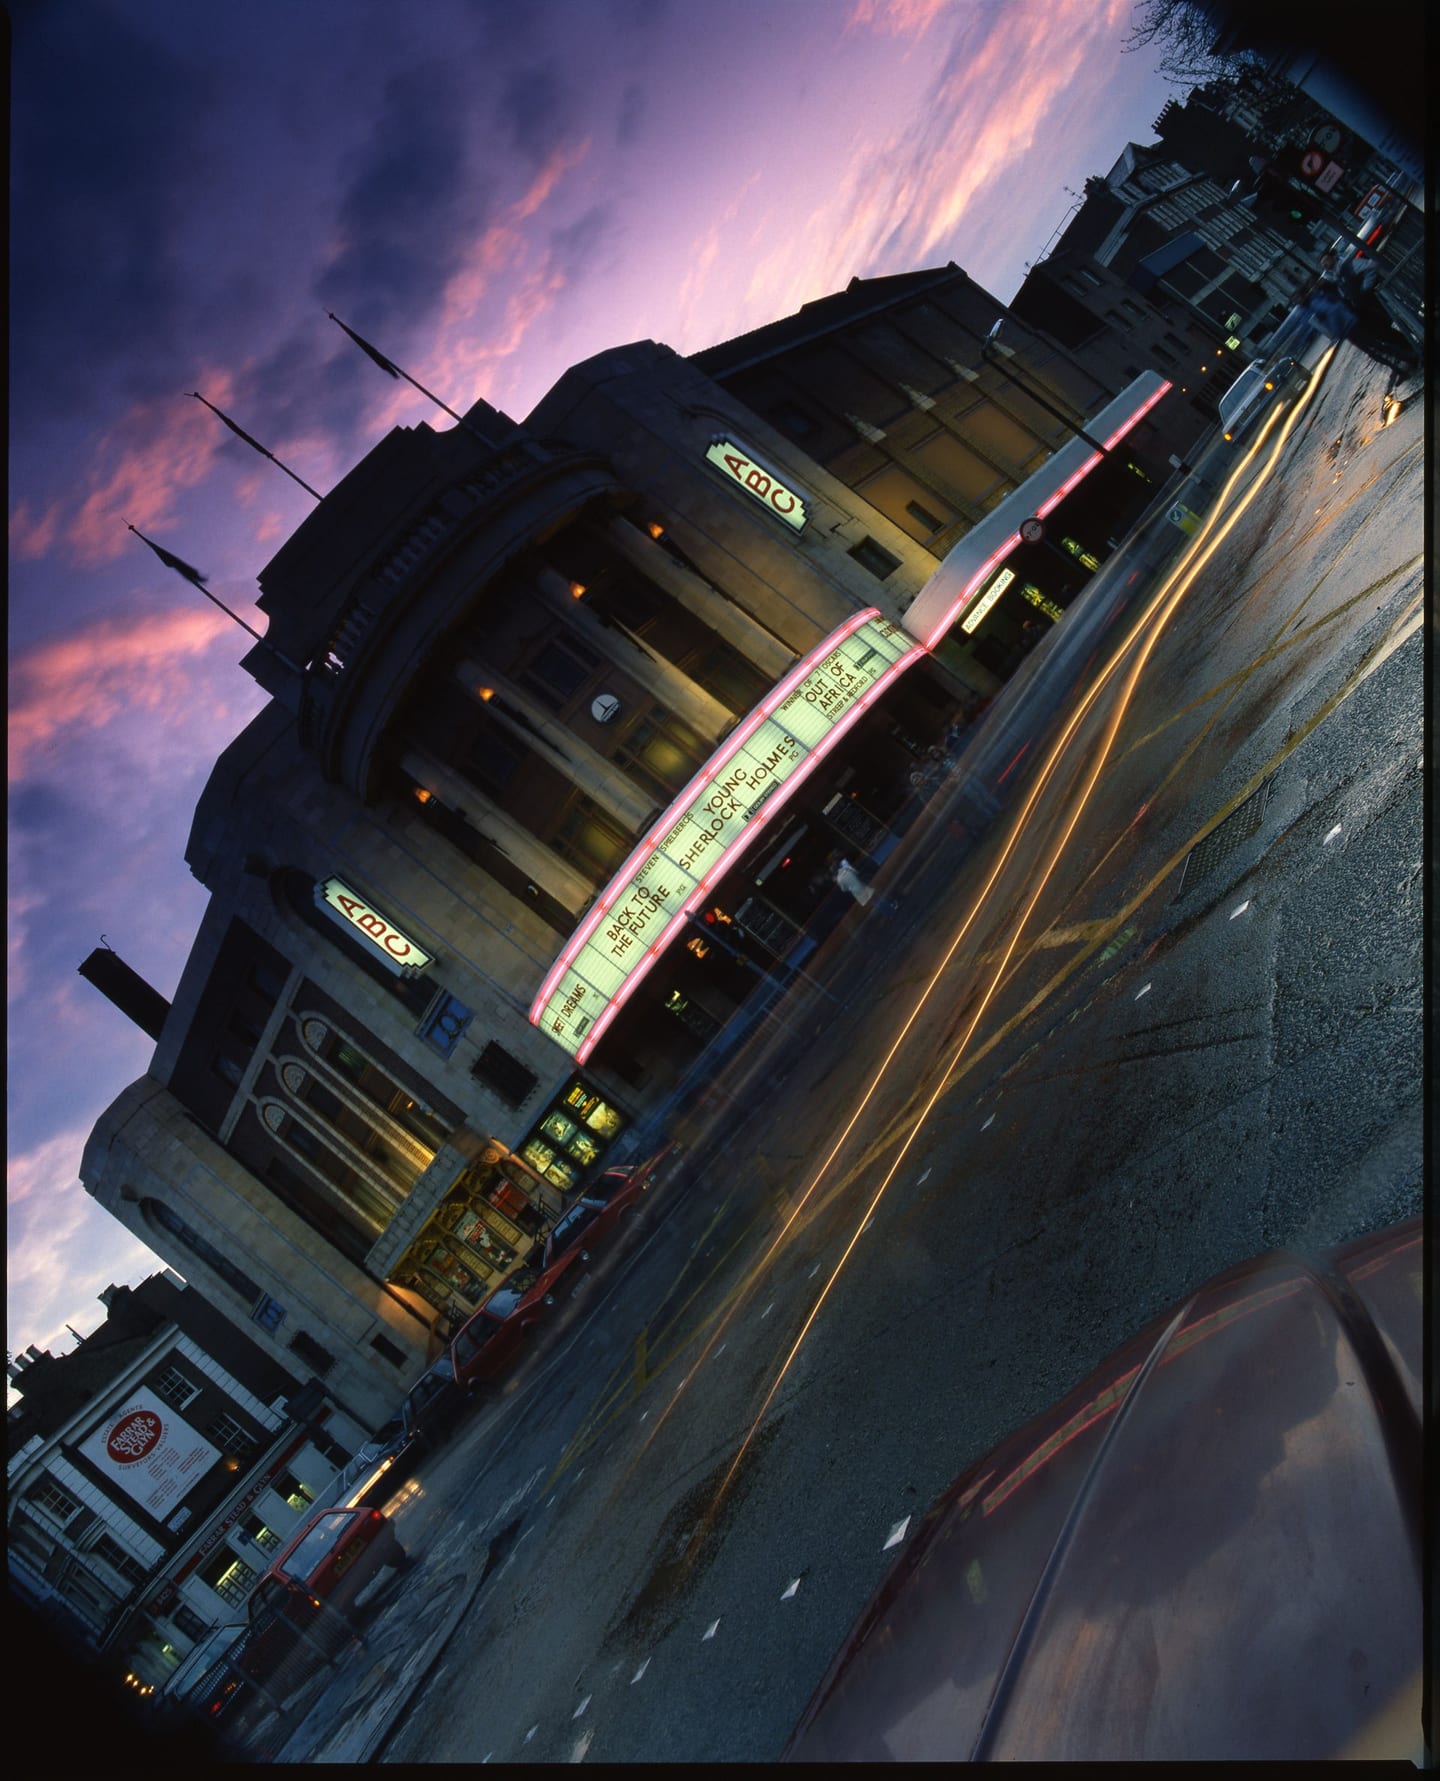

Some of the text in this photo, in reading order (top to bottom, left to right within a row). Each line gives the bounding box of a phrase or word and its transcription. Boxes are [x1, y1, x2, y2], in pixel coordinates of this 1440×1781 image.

[723, 454, 795, 513] ABC
[965, 571, 1012, 631] ADVANCE BOOKING
[780, 688, 803, 711] WINNER
[804, 679, 813, 688] OF
[821, 650, 842, 670] OSCARS
[805, 662, 845, 703] OUT OF
[819, 672, 857, 711] AFRICA
[827, 698, 845, 720] STREEP
[846, 675, 868, 698] REDFORD
[788, 750, 800, 762] PG
[679, 735, 796, 870] SHERLOCK HOLMES
[702, 768, 748, 815] YOUNG
[635, 854, 660, 883] STEVEN
[336, 894, 411, 956] ABC
[606, 886, 650, 941] BACK TO
[611, 885, 671, 957] THE FUTURE
[561, 983, 586, 1018] DREAMS
[111, 1416, 147, 1451] FARRAR
[119, 1418, 156, 1455] STEAD &
[130, 1429, 155, 1456] GLYN
[225, 1503, 247, 1528] STEAD
